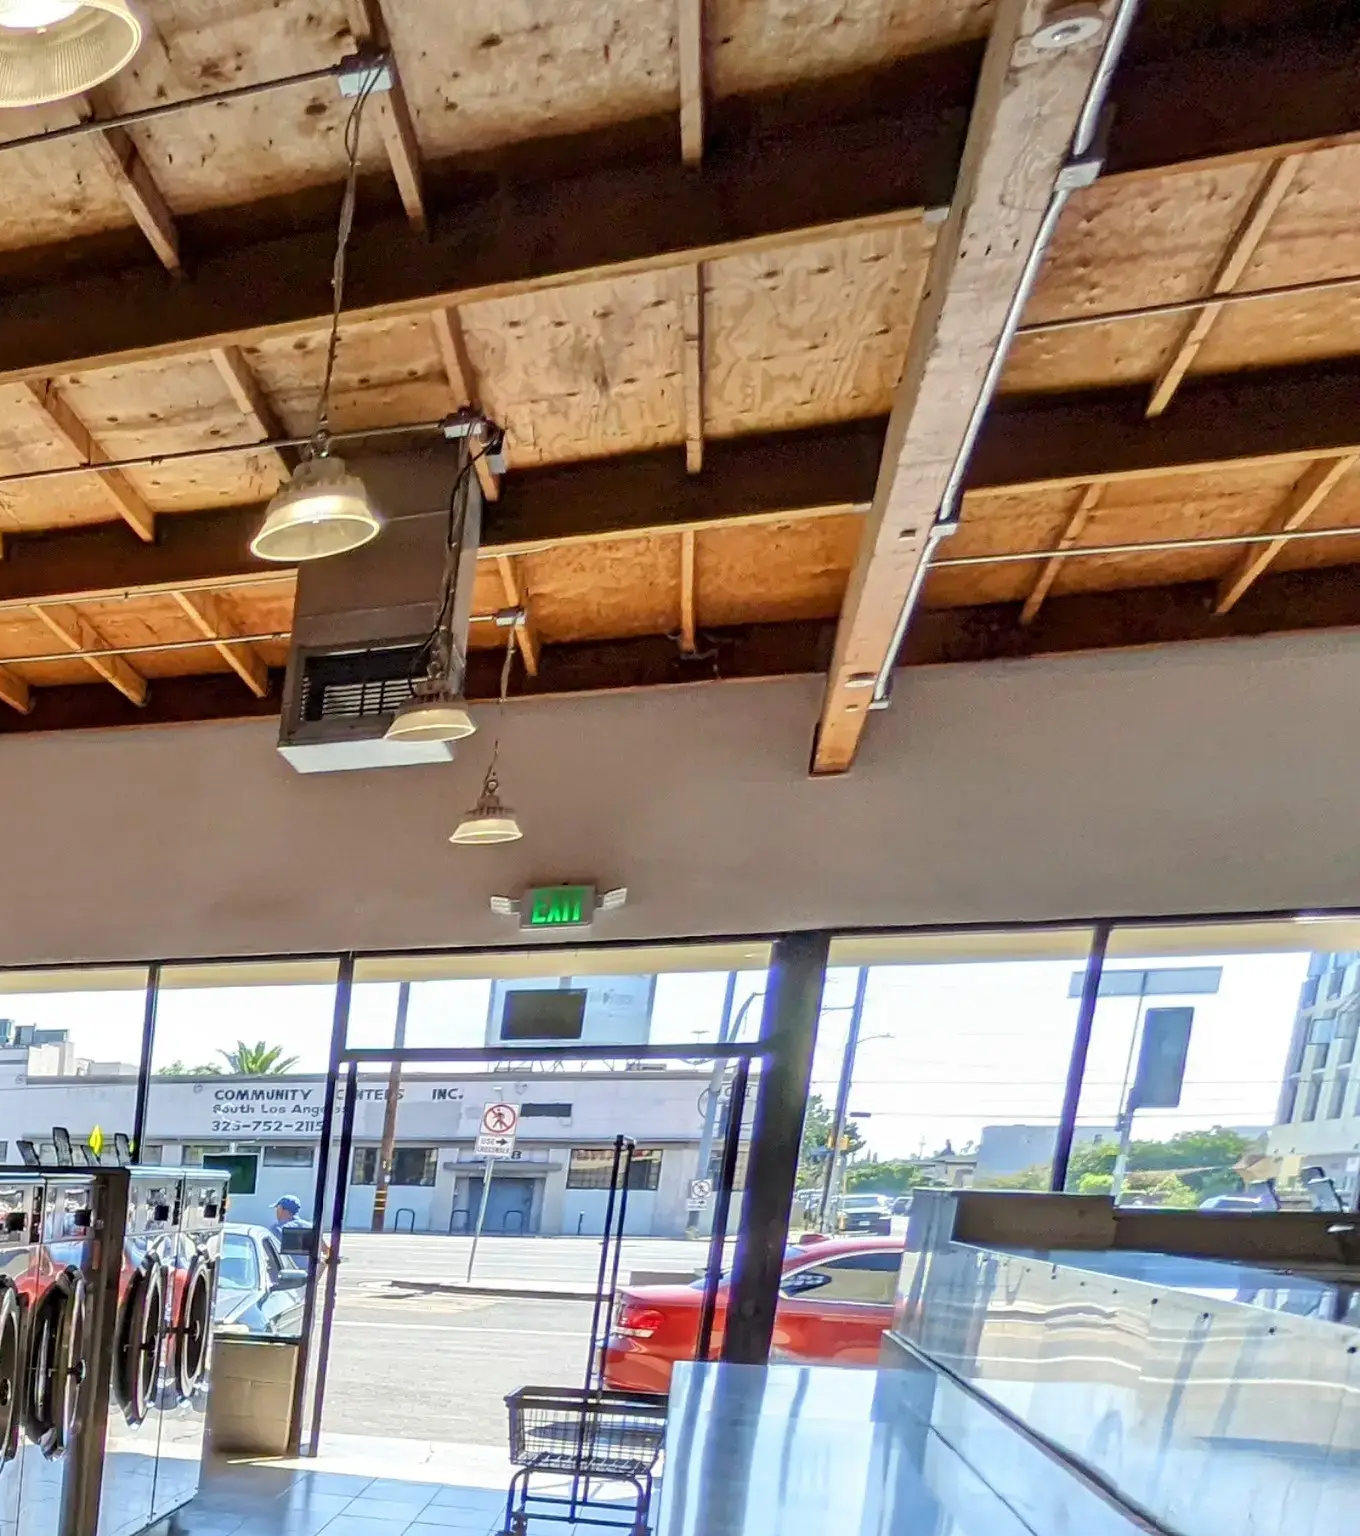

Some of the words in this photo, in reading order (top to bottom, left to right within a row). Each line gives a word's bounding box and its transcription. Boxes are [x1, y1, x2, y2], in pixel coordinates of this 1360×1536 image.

[531, 890, 583, 924] EXIT
[214, 1088, 313, 1101] COMMUNITY
[336, 1087, 405, 1101] CNTES
[431, 1087, 464, 1101] INC.
[212, 1103, 255, 1114] South
[261, 1103, 286, 1114] Los
[211, 1119, 325, 1132] 323-752-2115
